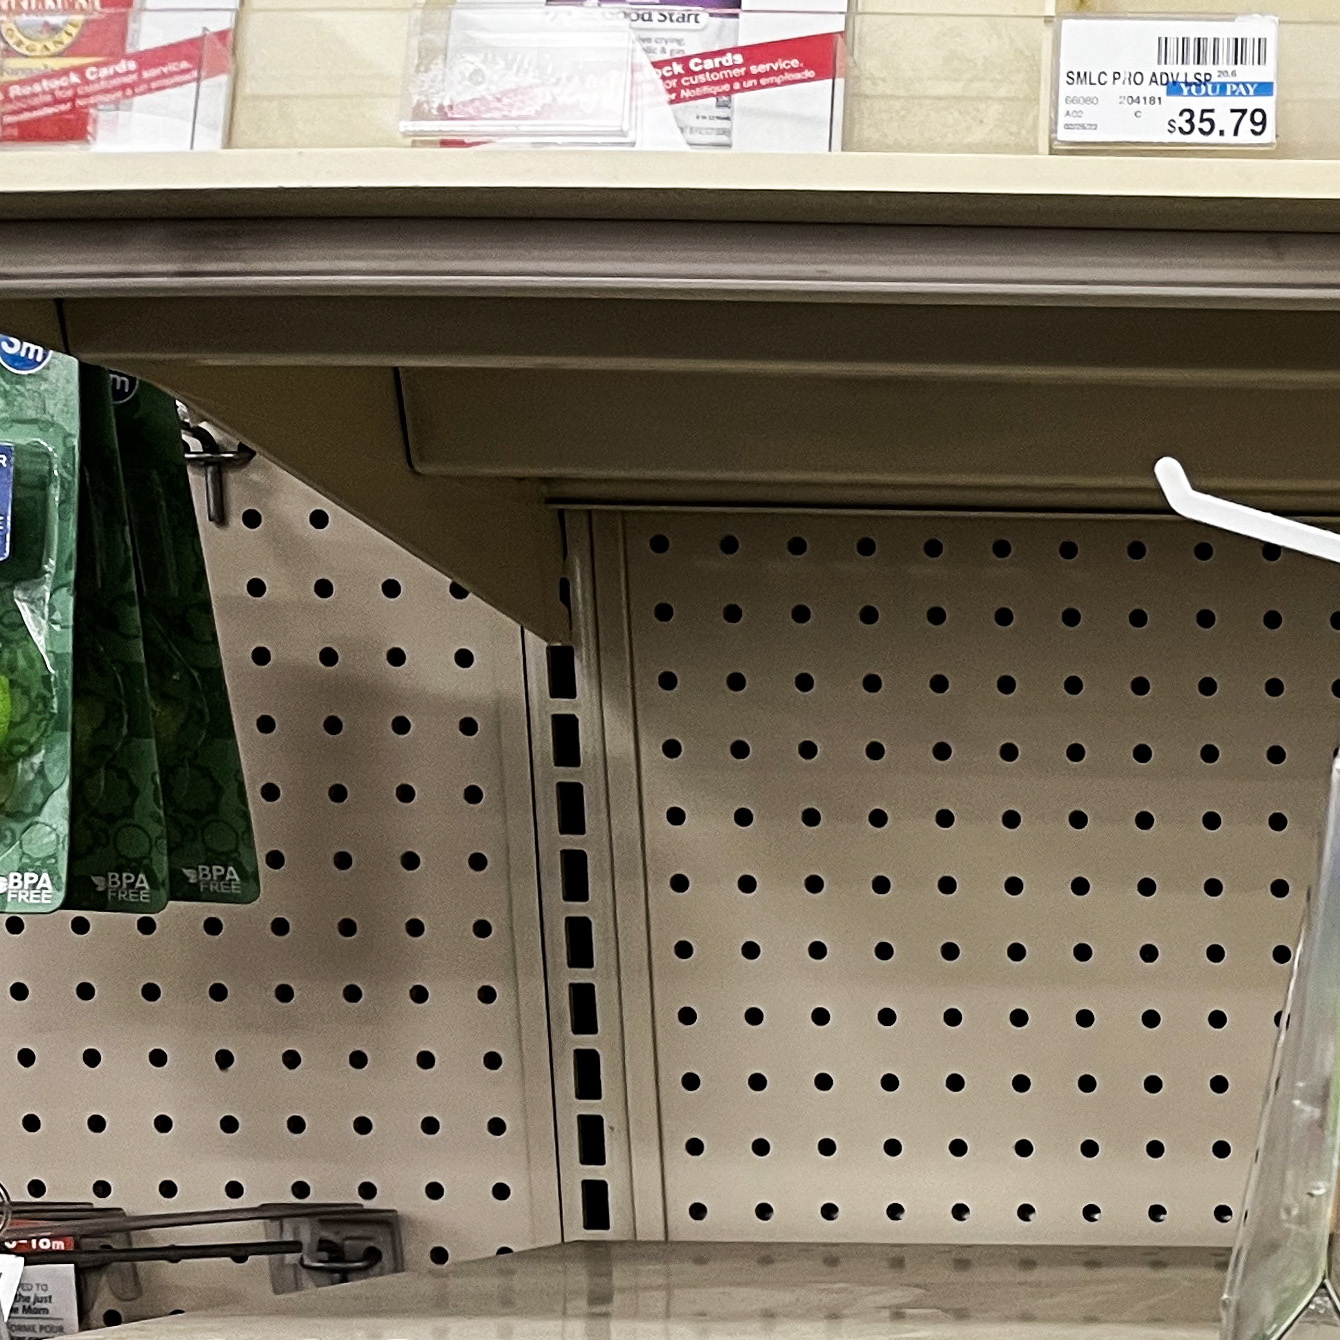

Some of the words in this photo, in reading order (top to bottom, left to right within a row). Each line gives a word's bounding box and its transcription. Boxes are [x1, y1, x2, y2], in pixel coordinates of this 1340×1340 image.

[688, 52, 744, 72] Cards
[681, 69, 745, 85] customer
[1066, 71, 1107, 85] SMLC
[1180, 83, 1220, 96] YOU
[1225, 84, 1258, 96] PAY
[1167, 108, 1268, 137] $35.79
[8, 872, 52, 890] BPA
[107, 872, 150, 890] BPA
[198, 865, 241, 882] BPA
[107, 889, 150, 902] FREE
[200, 881, 241, 894] FREE
[7, 890, 52, 903] FREE
